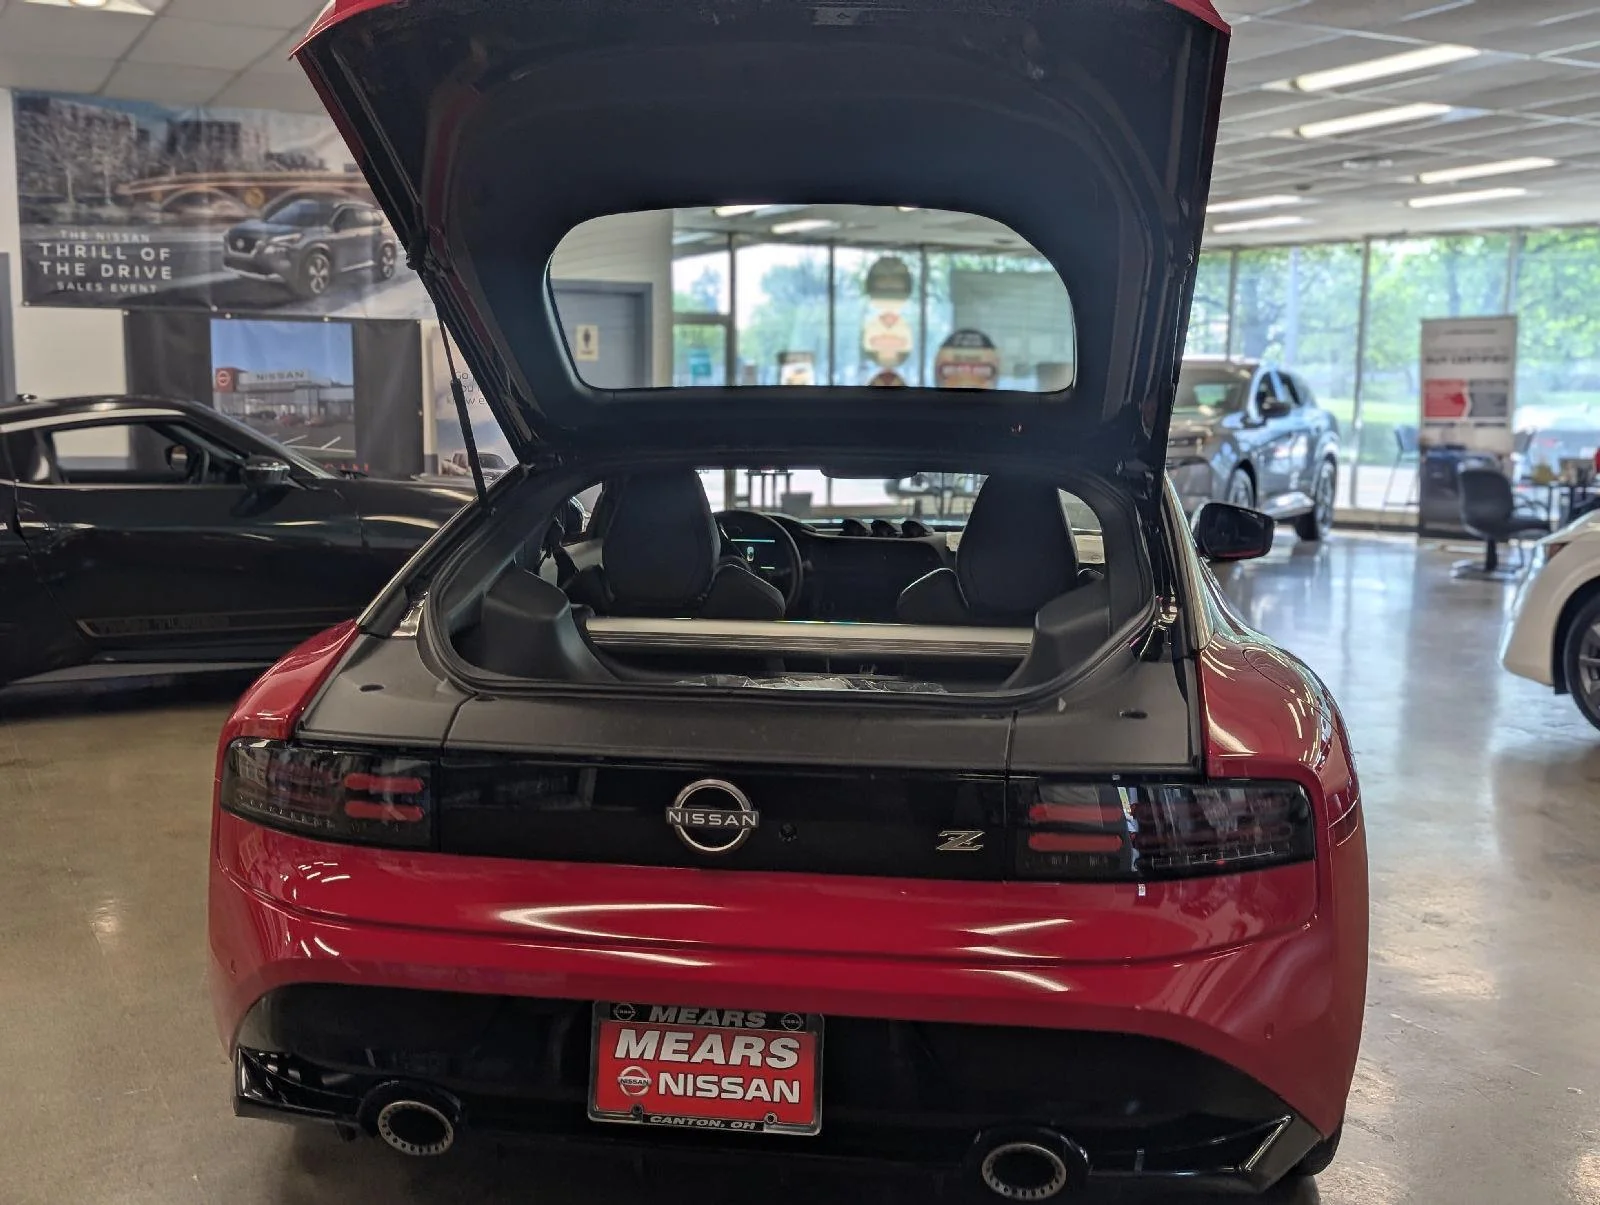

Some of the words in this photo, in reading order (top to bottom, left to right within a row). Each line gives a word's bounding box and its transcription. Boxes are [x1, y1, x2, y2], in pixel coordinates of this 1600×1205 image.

[60, 229, 88, 240] THE
[95, 231, 150, 243] NISSAN
[39, 243, 127, 260] THRILL
[140, 247, 172, 262] OF
[39, 261, 86, 277] THE
[101, 263, 172, 280] DRIVE
[56, 281, 103, 292] SALES
[110, 283, 157, 294] EVENT
[256, 371, 305, 381] NISSAN
[668, 811, 756, 826] NISSAN
[936, 830, 985, 851] Z
[649, 1006, 766, 1028] MEARS
[614, 1029, 800, 1069] MEARS
[620, 1078, 650, 1086] NISSAN
[658, 1072, 800, 1103] NISSAN
[650, 1115, 726, 1128] CANTON,
[730, 1120, 756, 1130] OH
